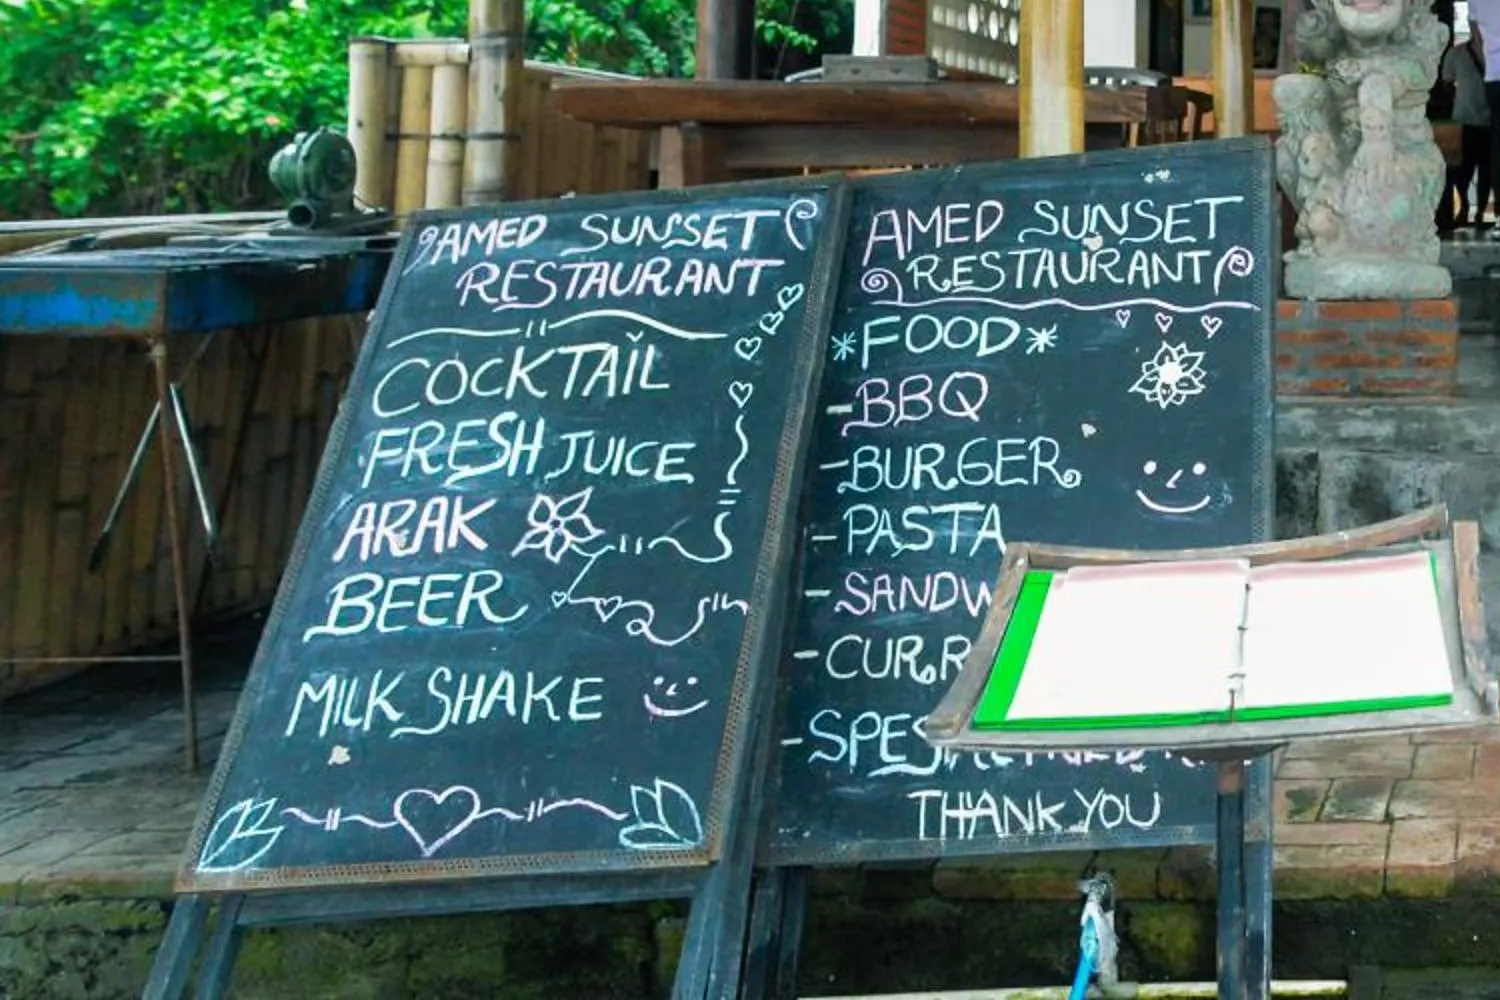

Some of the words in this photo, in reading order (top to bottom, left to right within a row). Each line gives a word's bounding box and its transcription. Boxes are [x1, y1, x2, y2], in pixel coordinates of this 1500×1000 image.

[431, 214, 547, 265] AMED
[559, 209, 781, 257] SUNSET
[861, 200, 1004, 266] AMED
[1018, 196, 1244, 243] SUNSET
[456, 256, 785, 312] RESTAURANT
[906, 249, 1212, 292] RESTAURANT
[861, 314, 1020, 369] FOOD
[372, 332, 670, 418] COCKTAIL
[361, 411, 543, 488] FRESH
[545, 430, 696, 483] JUICE
[332, 496, 500, 562] ARAK
[303, 569, 530, 641] BEER
[834, 571, 992, 616] SANDW
[826, 634, 972, 685] CURR
[285, 668, 402, 738] MILK
[390, 666, 604, 737] SHAKE
[908, 789, 1065, 842] THANK
[1071, 787, 1161, 832] YOU
